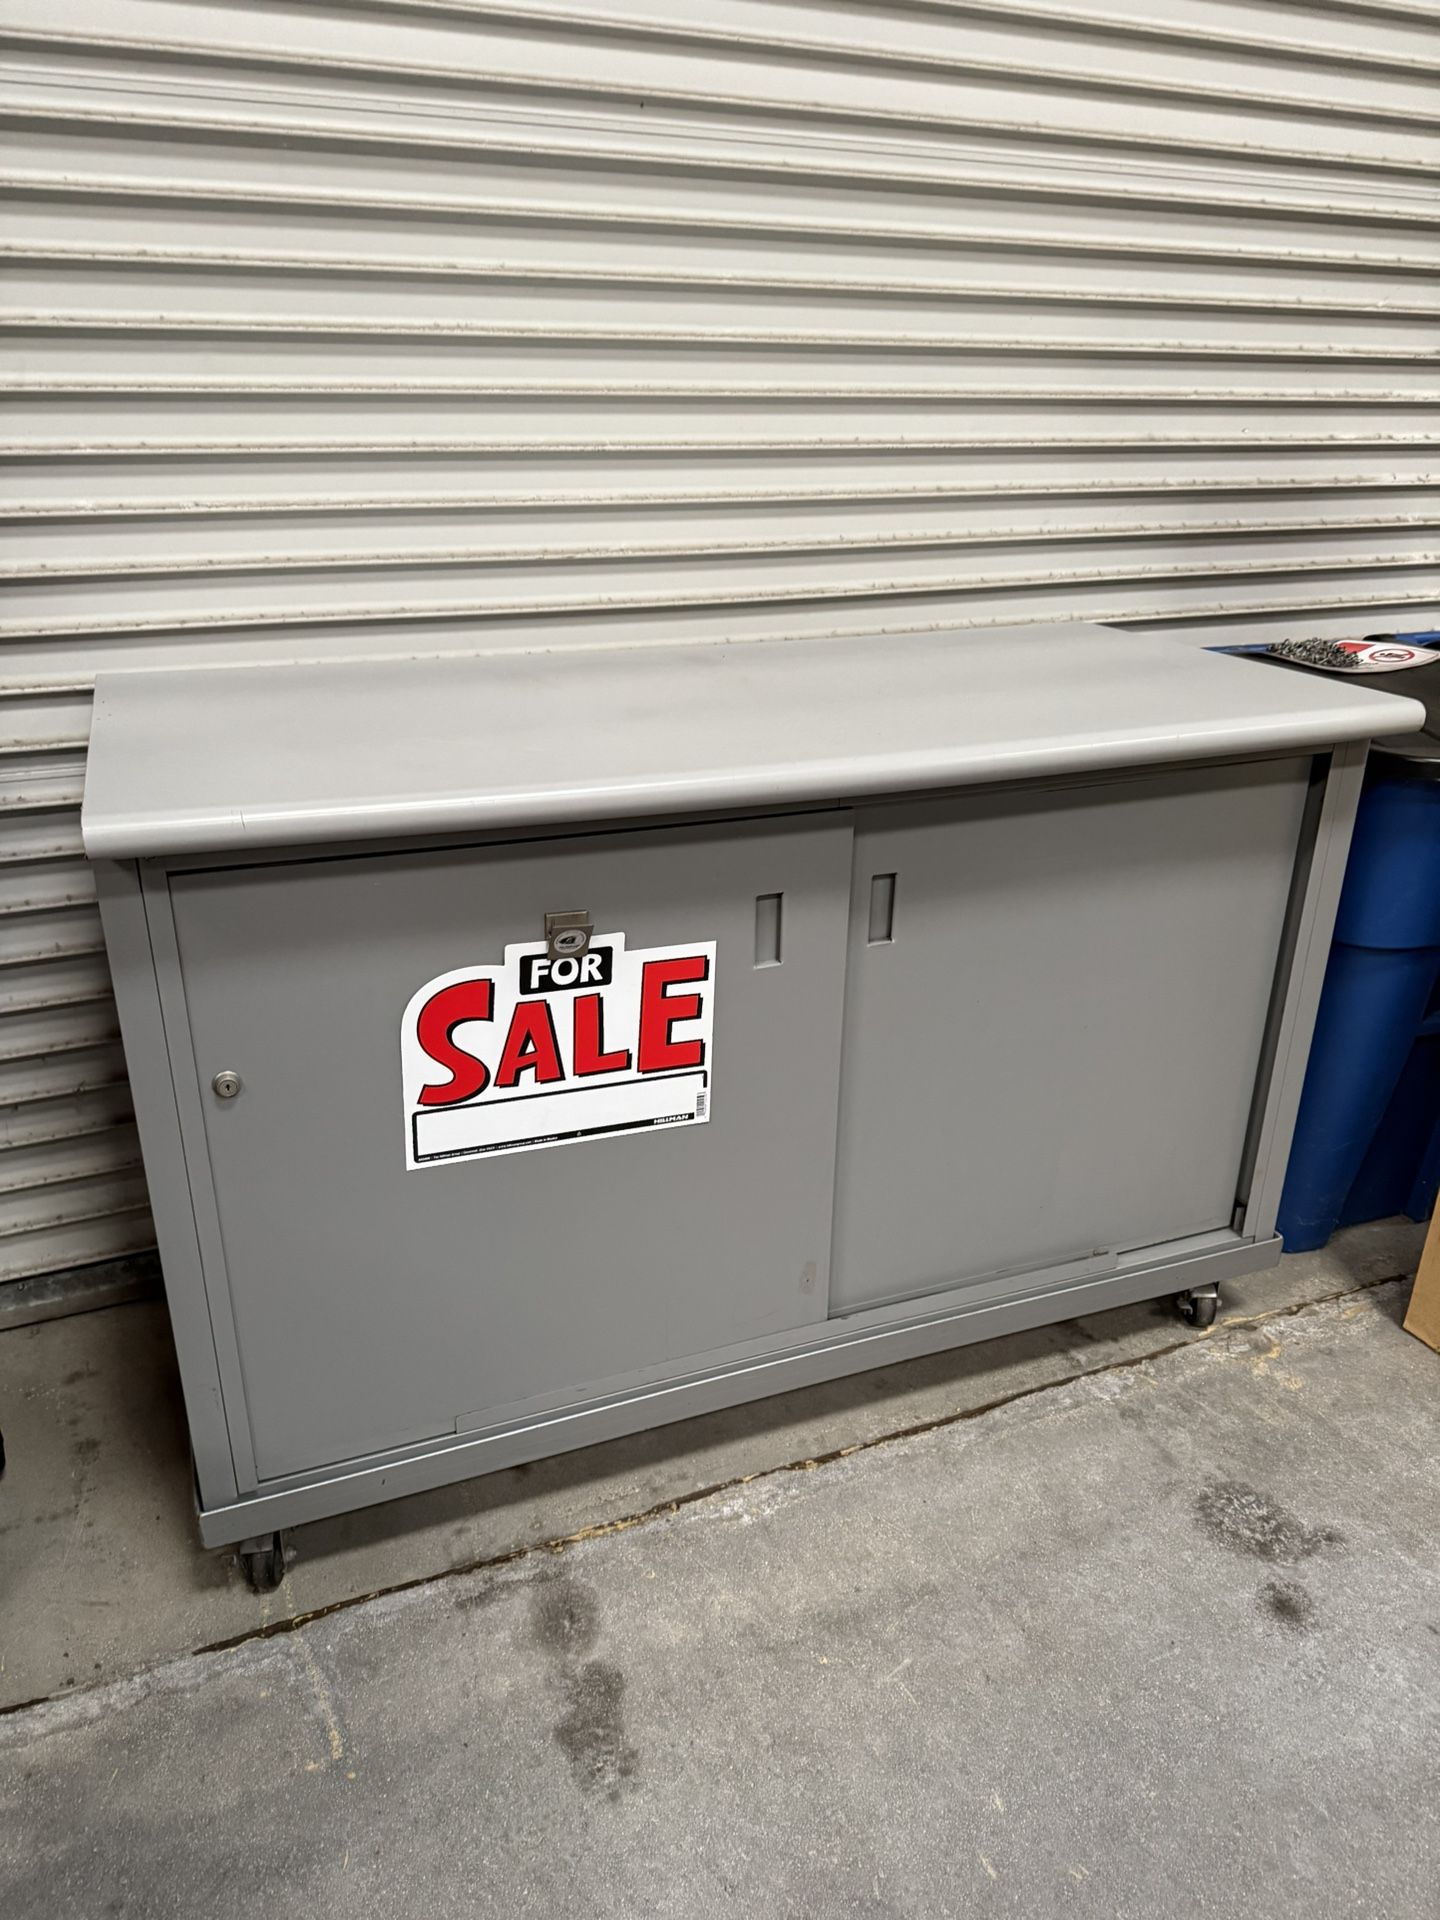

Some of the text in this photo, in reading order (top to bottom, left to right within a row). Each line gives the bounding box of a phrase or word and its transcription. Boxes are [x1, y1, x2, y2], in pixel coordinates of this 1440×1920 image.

[530, 954, 604, 989] FOR
[416, 955, 710, 1106] SALE
[653, 1114, 689, 1124] HILLMAN
